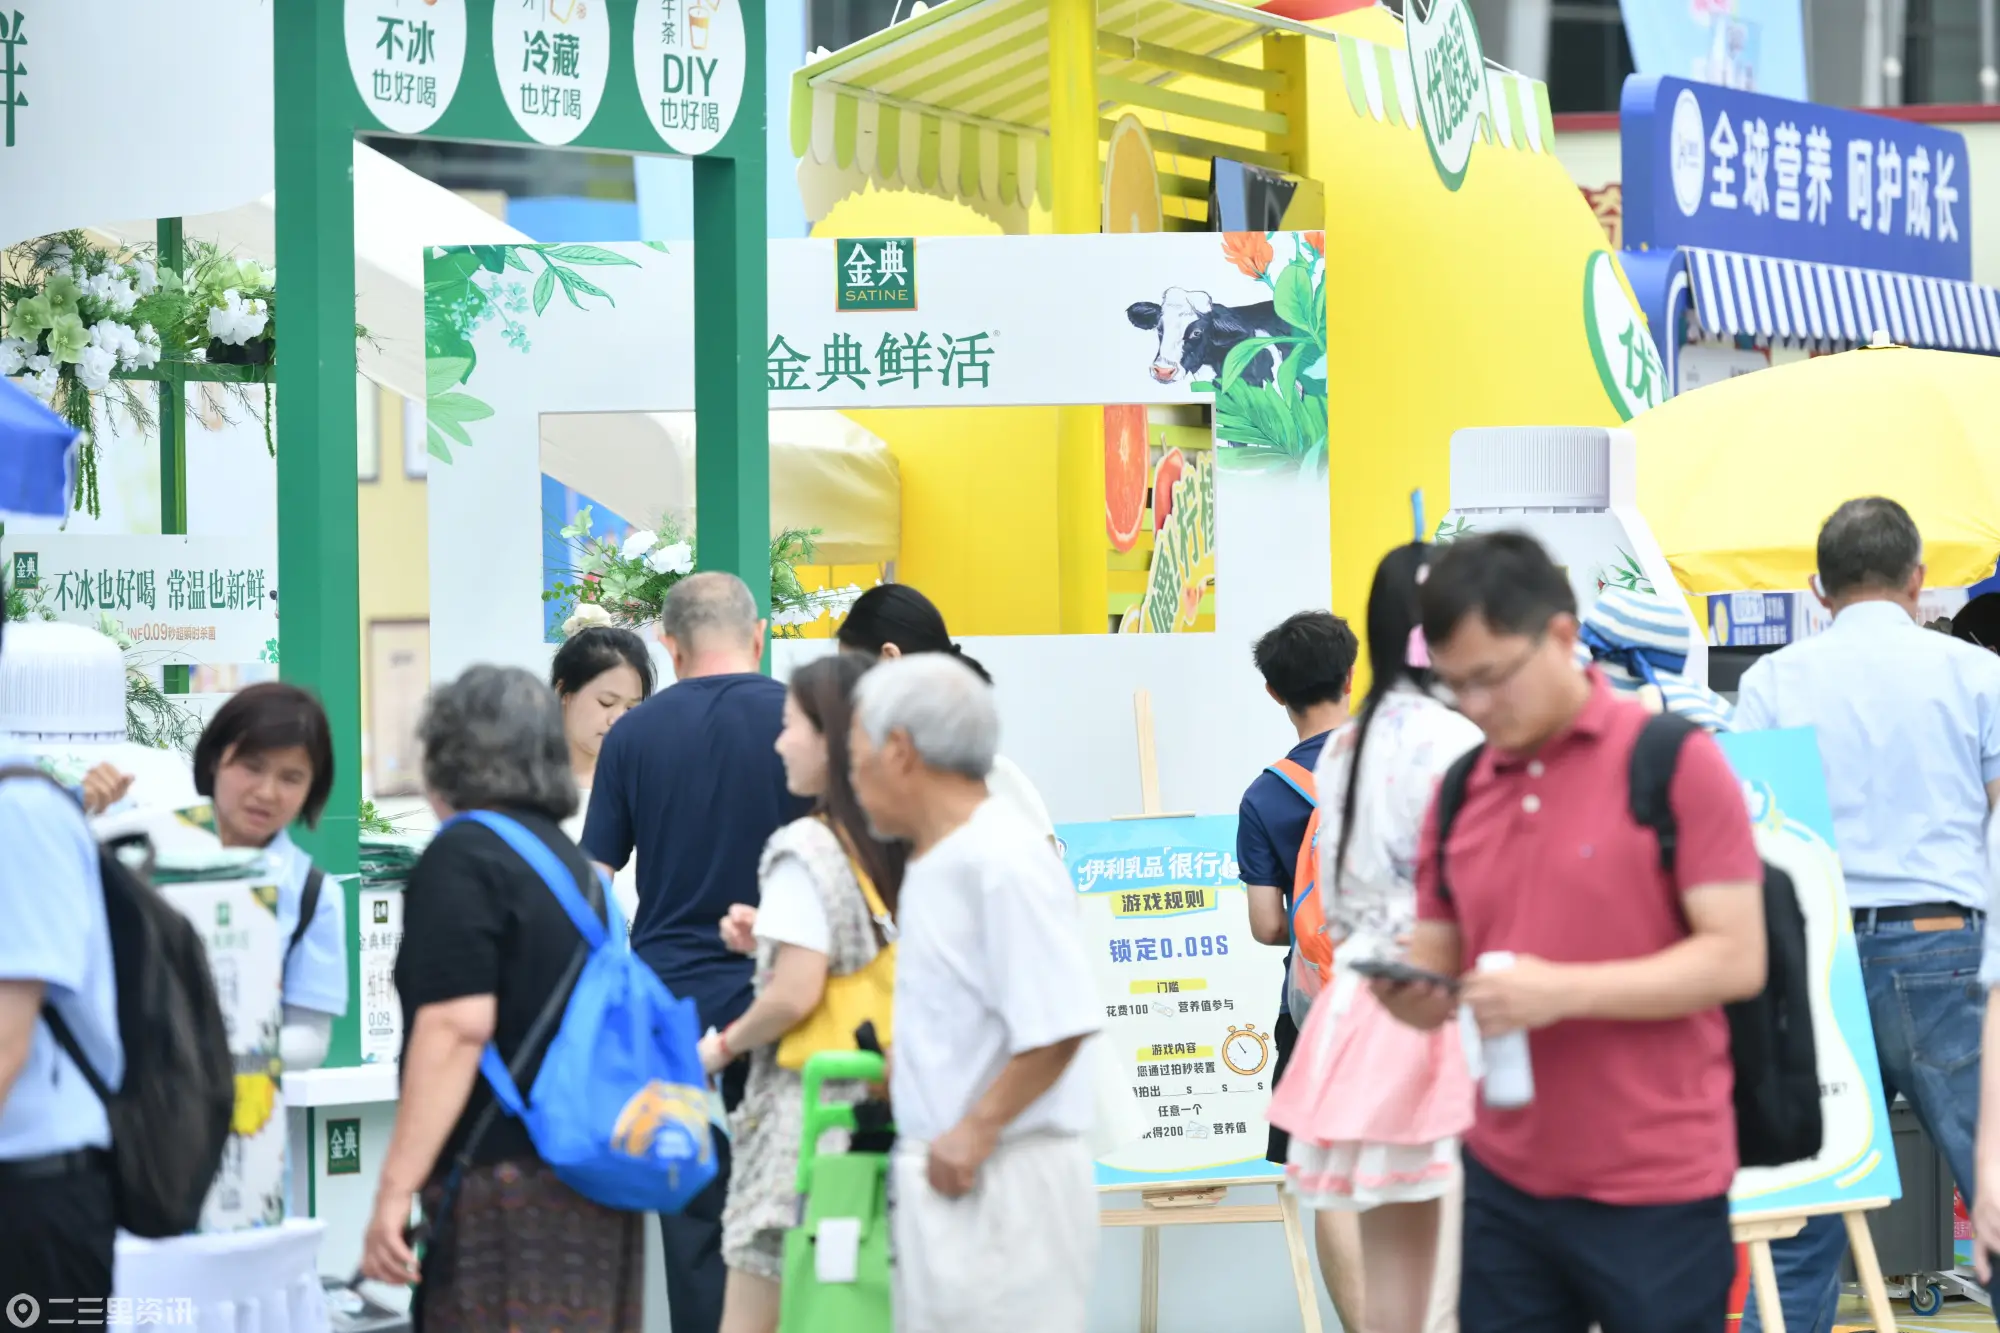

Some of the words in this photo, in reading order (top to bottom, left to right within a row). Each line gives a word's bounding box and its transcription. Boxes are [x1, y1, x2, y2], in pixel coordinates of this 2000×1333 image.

[375, 15, 435, 65] 不冰
[522, 29, 580, 79] 冷藏
[372, 68, 436, 108] 也好喝
[663, 53, 719, 97] DIY
[520, 82, 581, 120] 也好喝
[660, 97, 719, 133] 也好喝
[1709, 109, 1833, 227] 全球营养
[1847, 136, 1960, 243] 呵护成长
[843, 240, 908, 287] 金典
[845, 289, 909, 302] SATINE
[767, 330, 995, 392] 金典鲜活
[16, 556, 36, 578] 金典
[54, 568, 156, 611] 不冰也好喝
[167, 568, 265, 611] 常温也新鲜
[1122, 890, 1205, 912] 游戏规则
[1109, 935, 1229, 963] 锁定0.09S
[1156, 981, 1180, 994] 门槛
[1105, 1004, 1149, 1018] 花费100
[1178, 999, 1234, 1013] 营养值参与
[1151, 1042, 1197, 1056] 游戏内容
[1137, 1061, 1216, 1078] 您通过拍秒装置
[1158, 1104, 1202, 1117] 任意一个
[330, 1126, 357, 1159] 金典
[1213, 1122, 1247, 1135] 营养值
